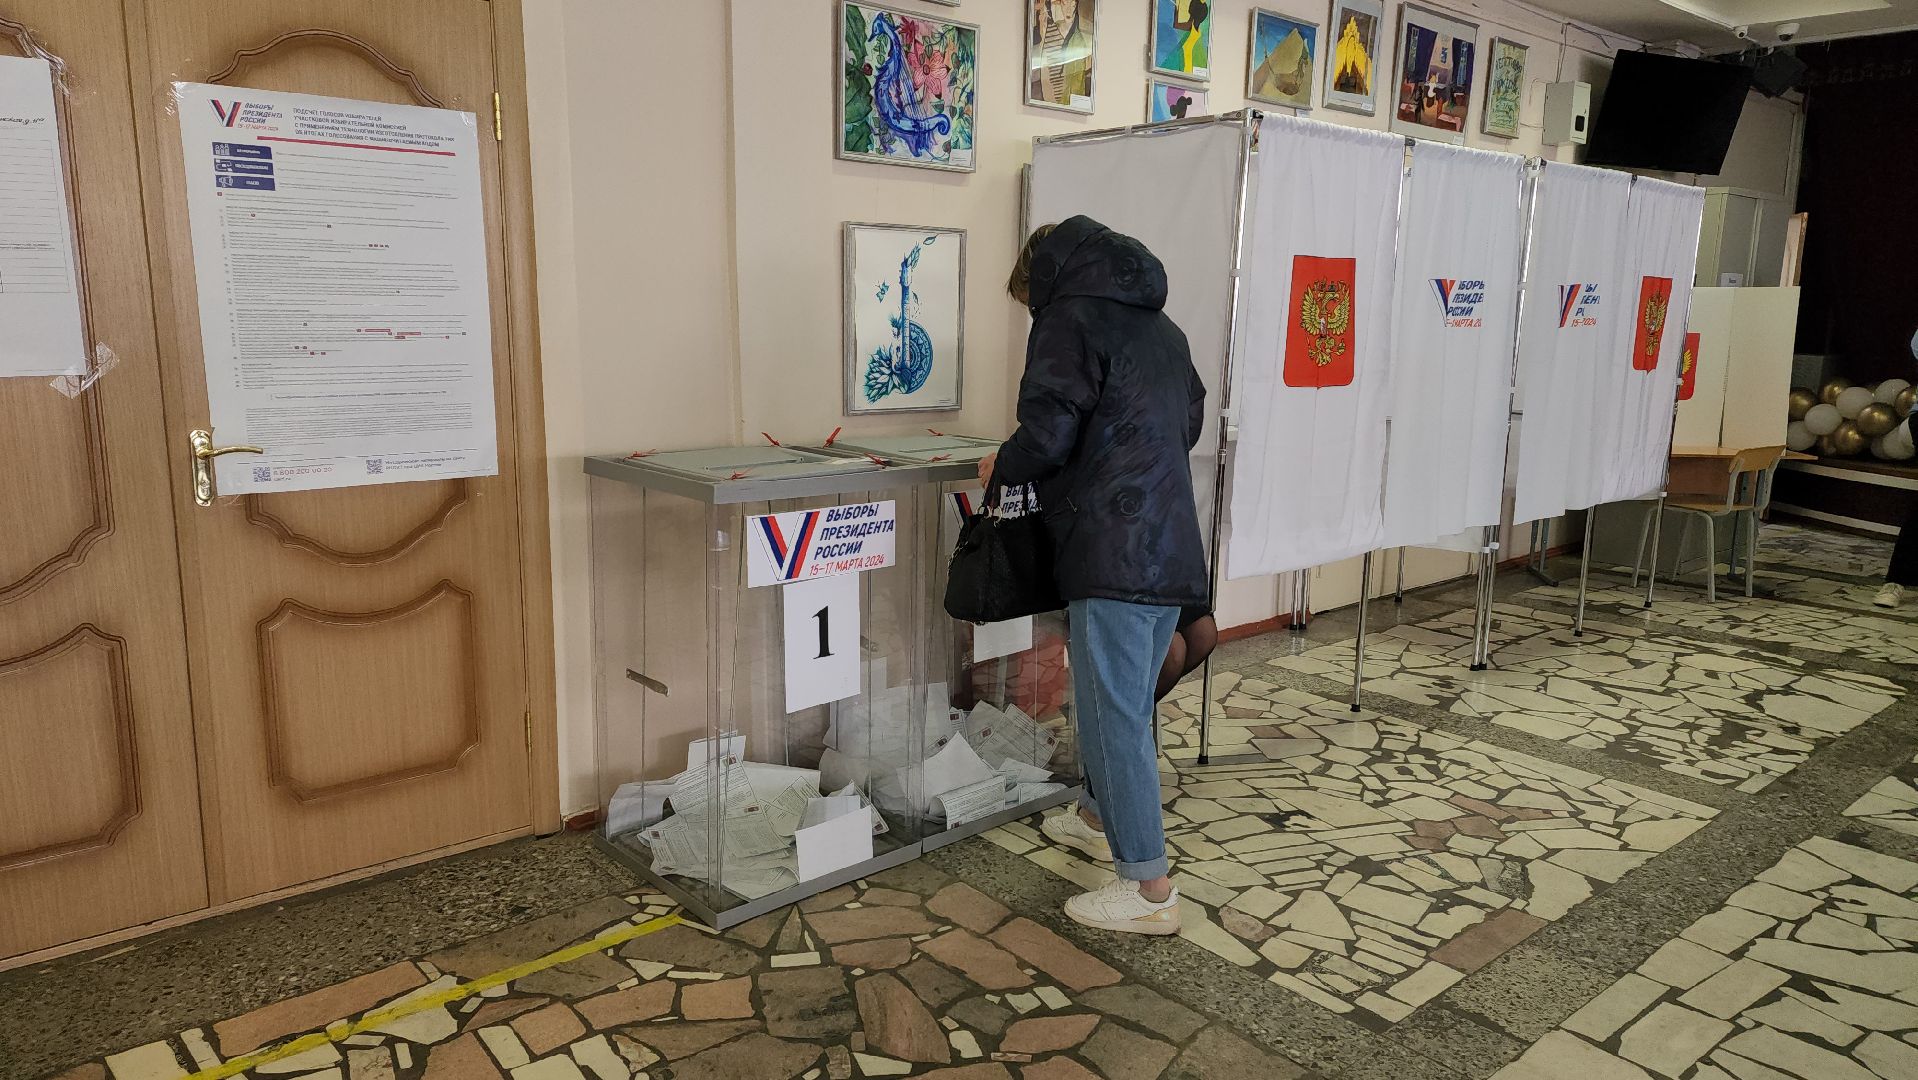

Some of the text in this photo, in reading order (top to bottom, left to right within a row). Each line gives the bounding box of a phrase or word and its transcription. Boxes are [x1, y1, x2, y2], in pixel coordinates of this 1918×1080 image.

[242, 110, 283, 119] ПРЕЗИДЕНТА
[245, 103, 274, 111] ВЫБОРЫ
[240, 116, 266, 124] РОССИИ
[826, 504, 880, 522] ВЫБОРЫ
[820, 519, 894, 541] ПРЕЗИДЕНТА
[814, 541, 863, 560] РОССИИ
[835, 558, 862, 572] МАРТА
[864, 554, 885, 568] 2024
[812, 605, 835, 660] 1
